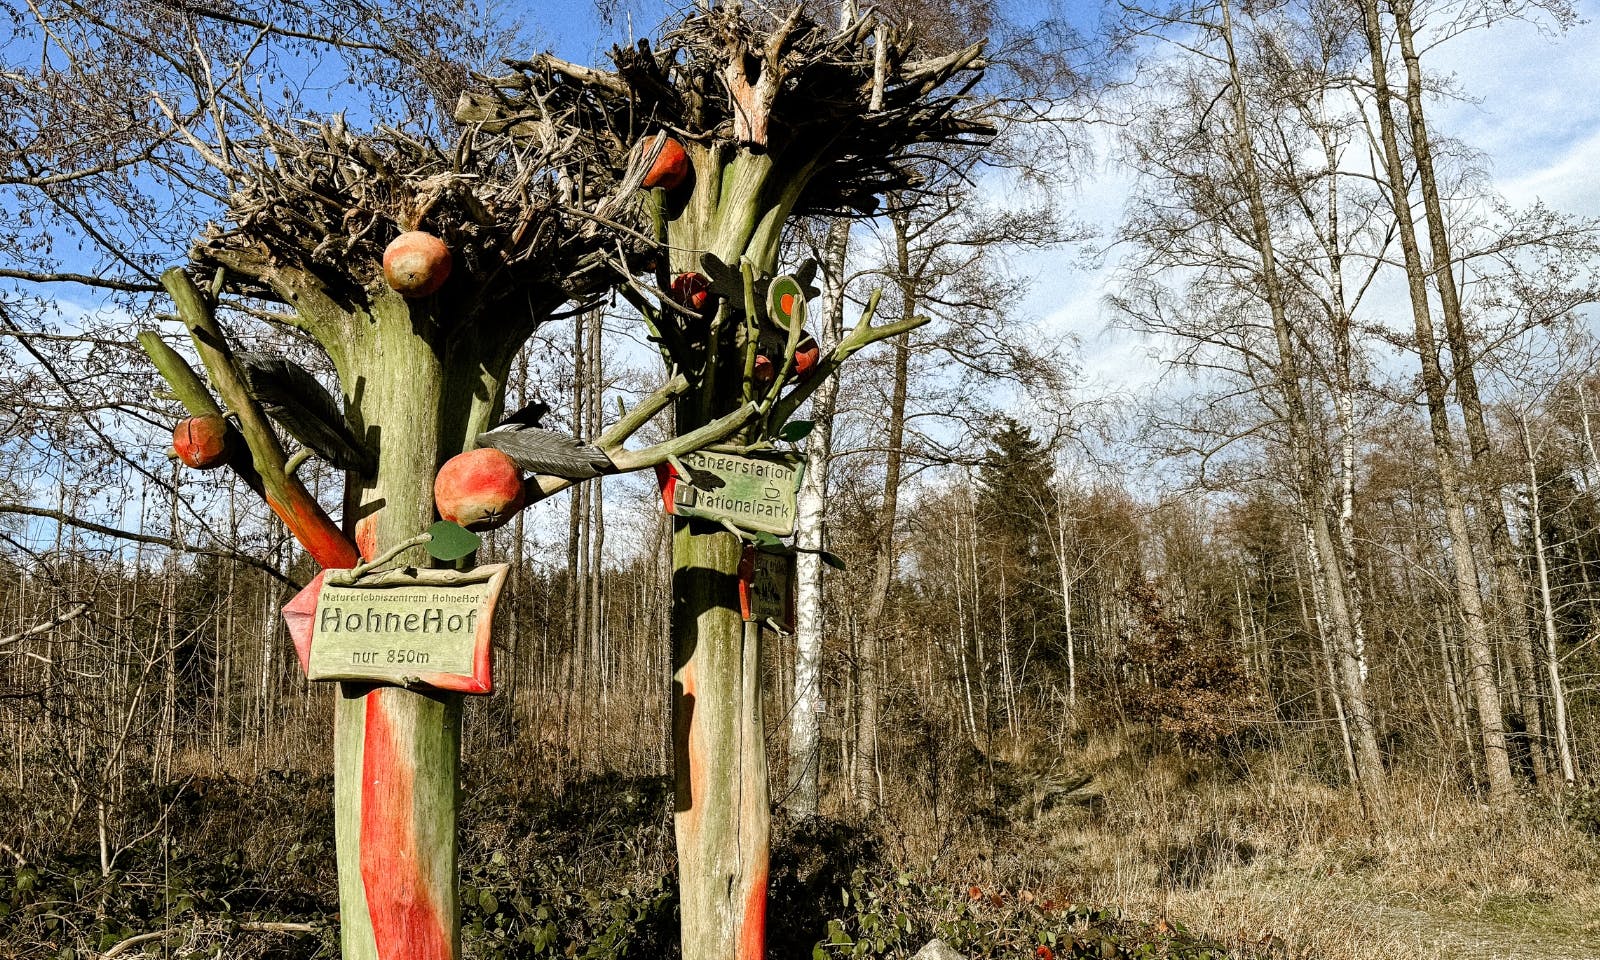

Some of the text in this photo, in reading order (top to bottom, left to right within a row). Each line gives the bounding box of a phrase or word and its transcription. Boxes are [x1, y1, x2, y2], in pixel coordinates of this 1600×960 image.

[688, 453, 792, 480] Rangerstation
[697, 491, 789, 518] Nationalpark
[432, 594, 480, 604] HohneHof
[320, 607, 478, 634] HohneHof
[352, 649, 430, 664] nur 850m
